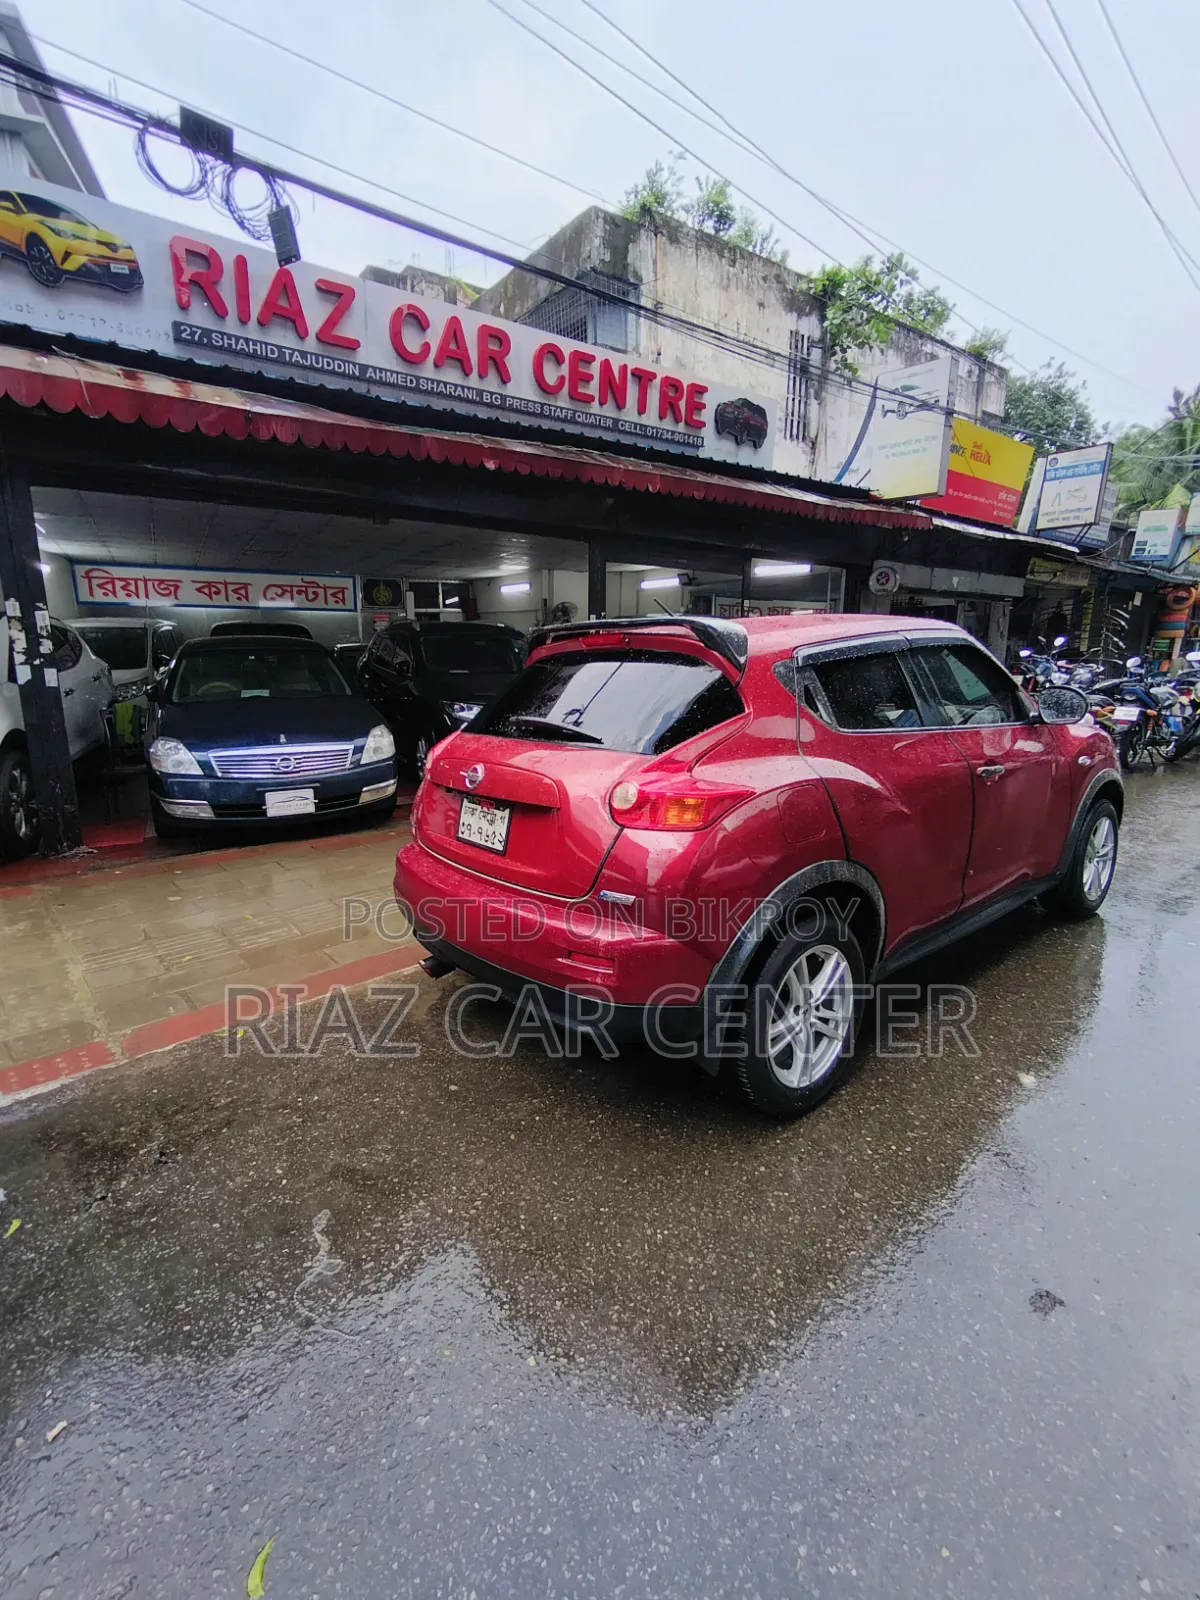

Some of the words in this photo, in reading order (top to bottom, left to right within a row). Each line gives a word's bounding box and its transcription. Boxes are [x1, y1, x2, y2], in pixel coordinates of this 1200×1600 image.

[169, 235, 361, 350] RIAZ
[389, 303, 512, 384] CAR
[532, 342, 708, 428] CENTRE
[180, 325, 208, 344] 27,
[211, 332, 278, 359] SHAHID
[281, 348, 360, 376] TAJUDDIN
[366, 366, 417, 388] AHMED
[419, 379, 479, 402] SHARANI,
[506, 397, 541, 414] PRESS
[543, 403, 574, 420] STAFF
[575, 411, 613, 428] QUATER
[618, 420, 645, 435] CELL:
[81, 568, 183, 600] রিয়াজ
[191, 579, 252, 603] কার
[263, 577, 349, 606] সেন্টার
